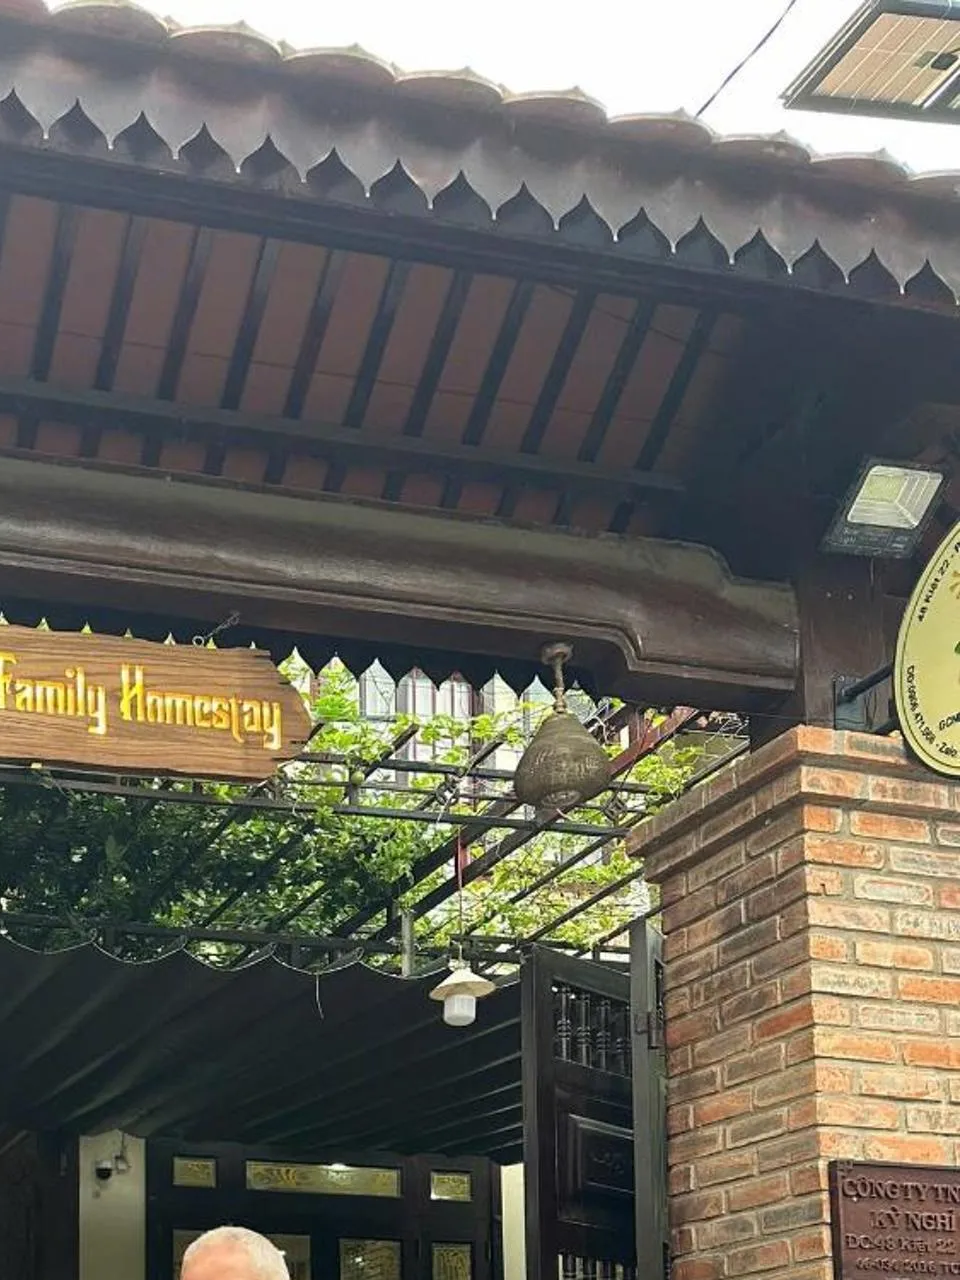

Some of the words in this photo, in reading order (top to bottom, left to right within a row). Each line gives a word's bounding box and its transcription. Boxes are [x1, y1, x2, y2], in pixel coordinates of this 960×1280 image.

[119, 662, 282, 751] Homestay
[842, 1175, 900, 1200] CÔNG
[903, 1181, 928, 1202] TY
